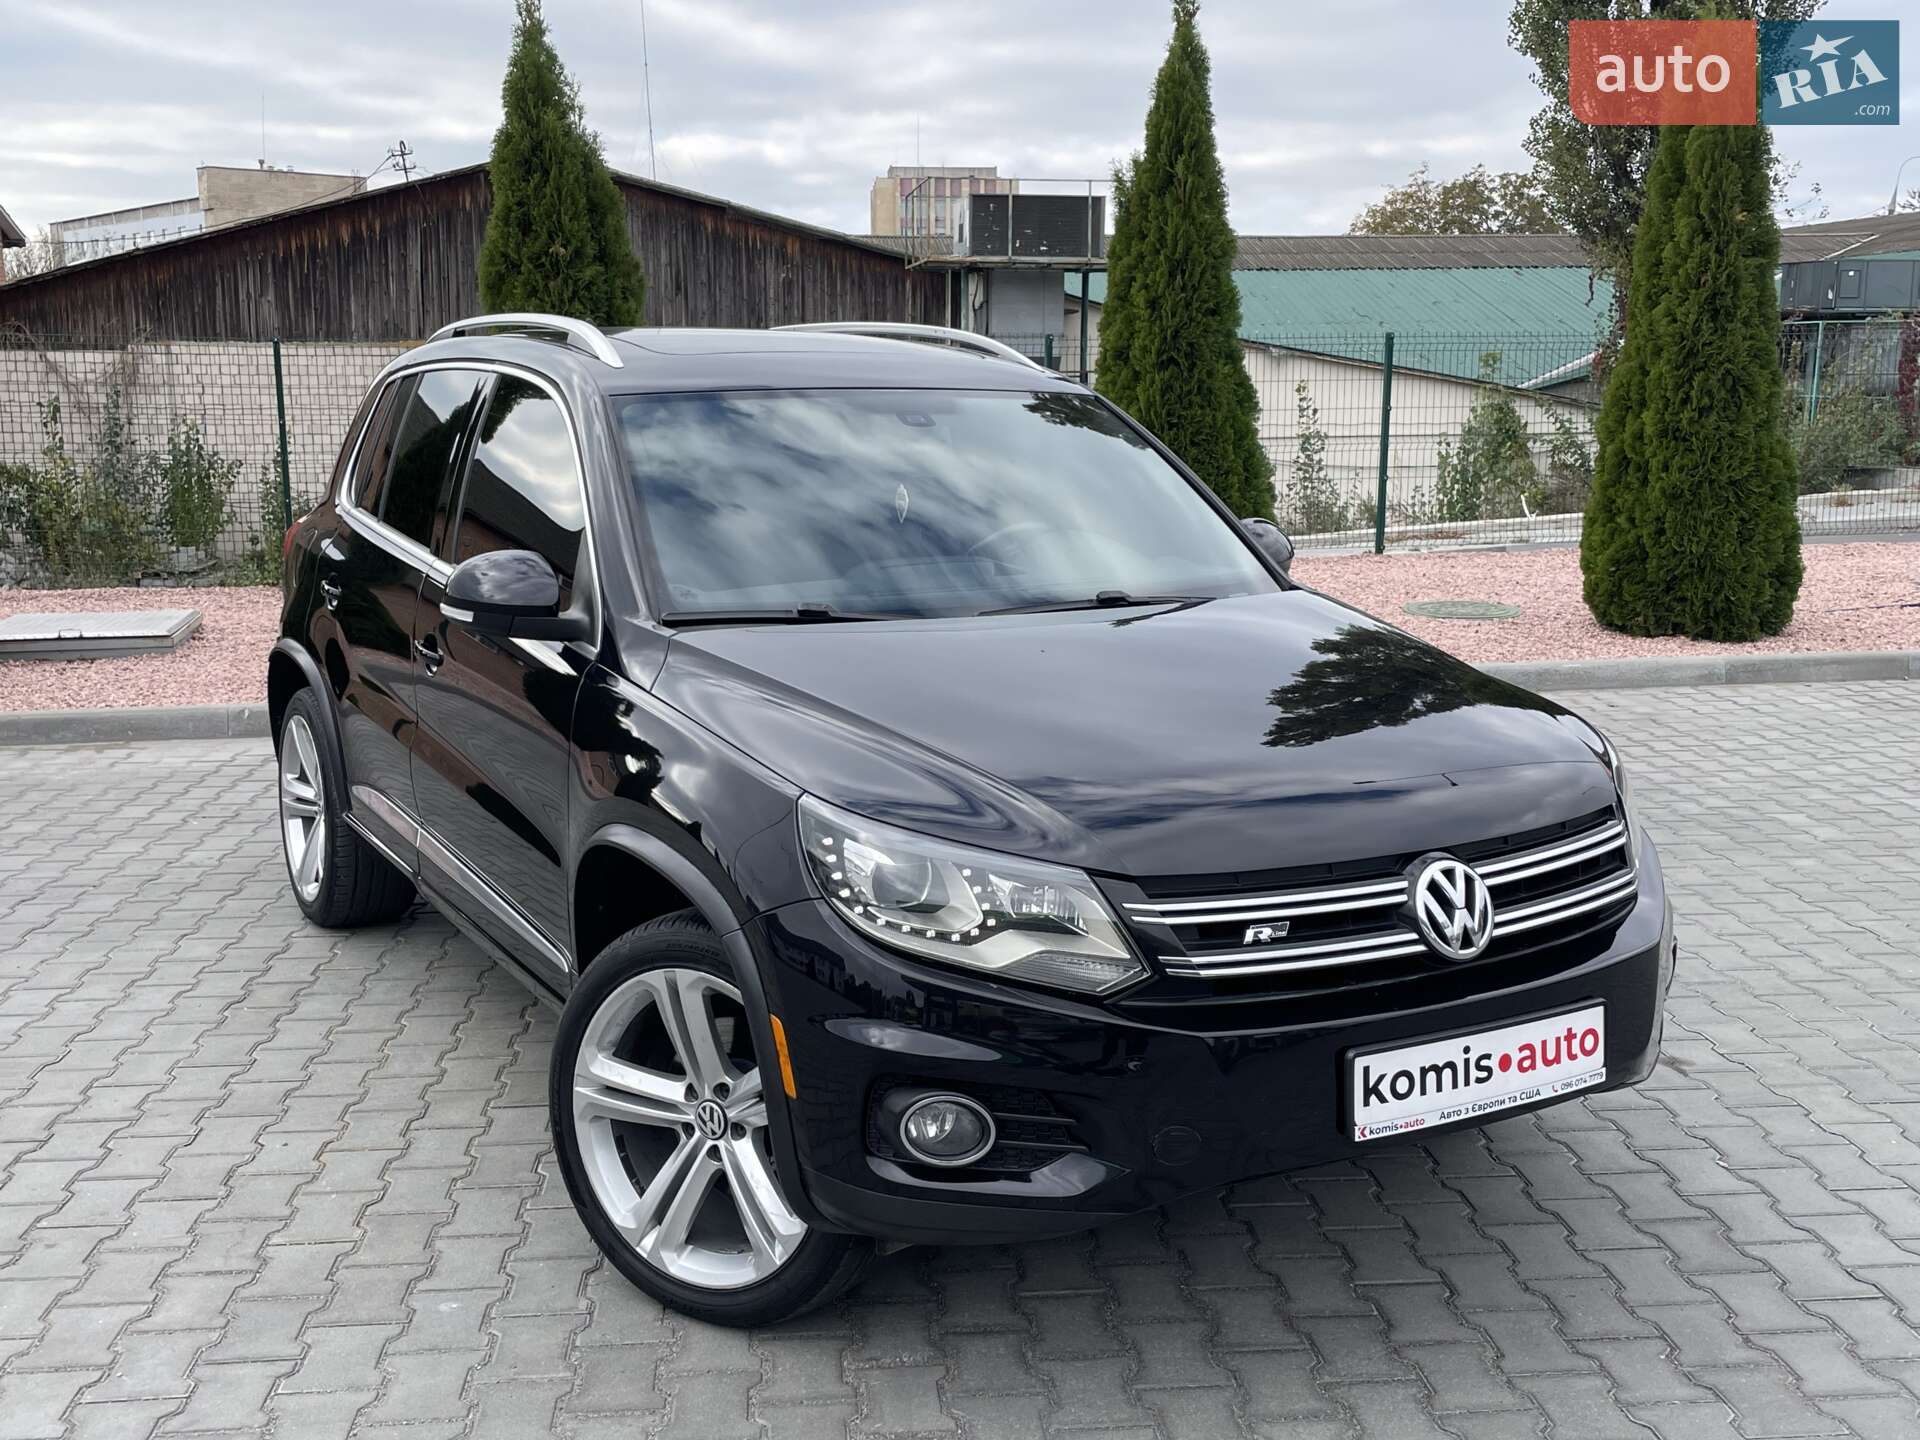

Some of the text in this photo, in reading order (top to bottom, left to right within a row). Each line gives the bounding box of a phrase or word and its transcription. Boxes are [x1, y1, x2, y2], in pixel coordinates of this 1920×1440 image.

[1560, 1080, 1574, 1090] 096
[1574, 1077, 1588, 1087] 074
[1439, 1088, 1542, 1121] Авто з Європи та США
